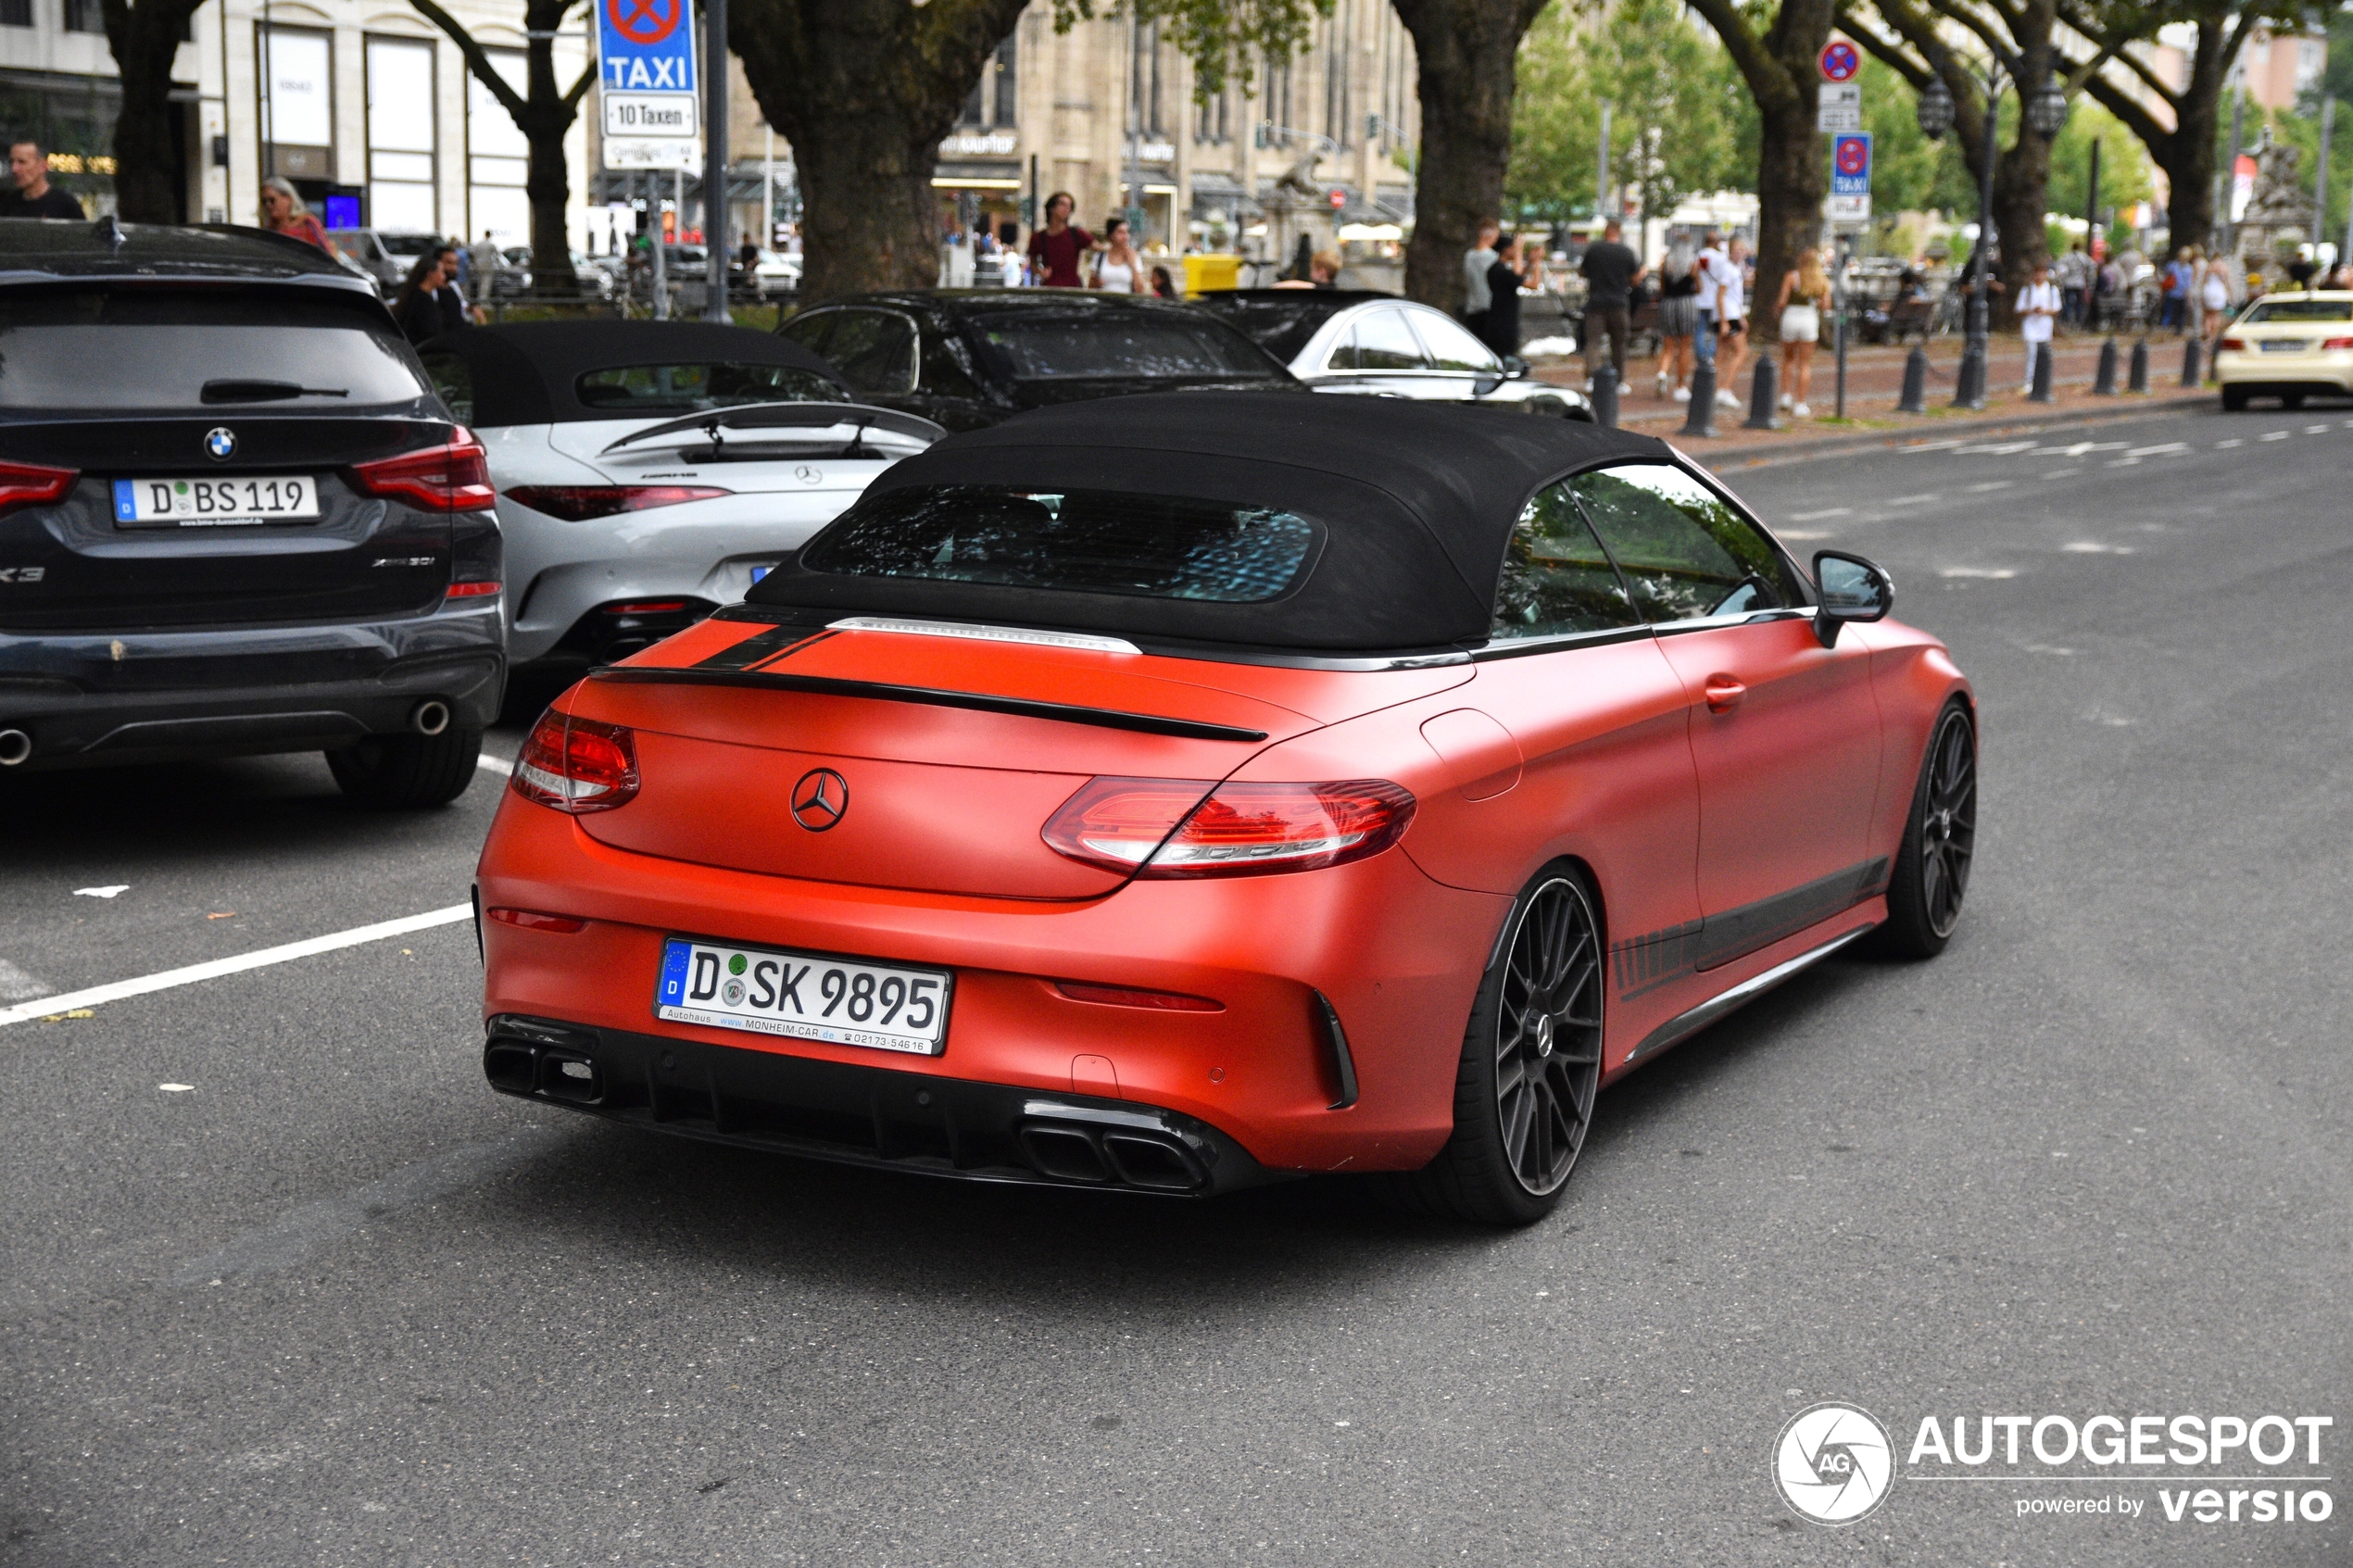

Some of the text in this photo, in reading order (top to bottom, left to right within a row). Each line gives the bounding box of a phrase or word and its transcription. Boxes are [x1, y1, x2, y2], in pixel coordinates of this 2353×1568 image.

[607, 56, 686, 88] TAXI
[619, 105, 682, 124] 10 Taxen
[150, 482, 303, 514] D BS 119
[668, 980, 677, 994] D
[689, 951, 720, 1000] D
[749, 960, 812, 1015] SK
[820, 969, 938, 1029] 9895
[666, 1009, 925, 1050] Autohaus www.MONHEIM-CAR.de 02173-54616
